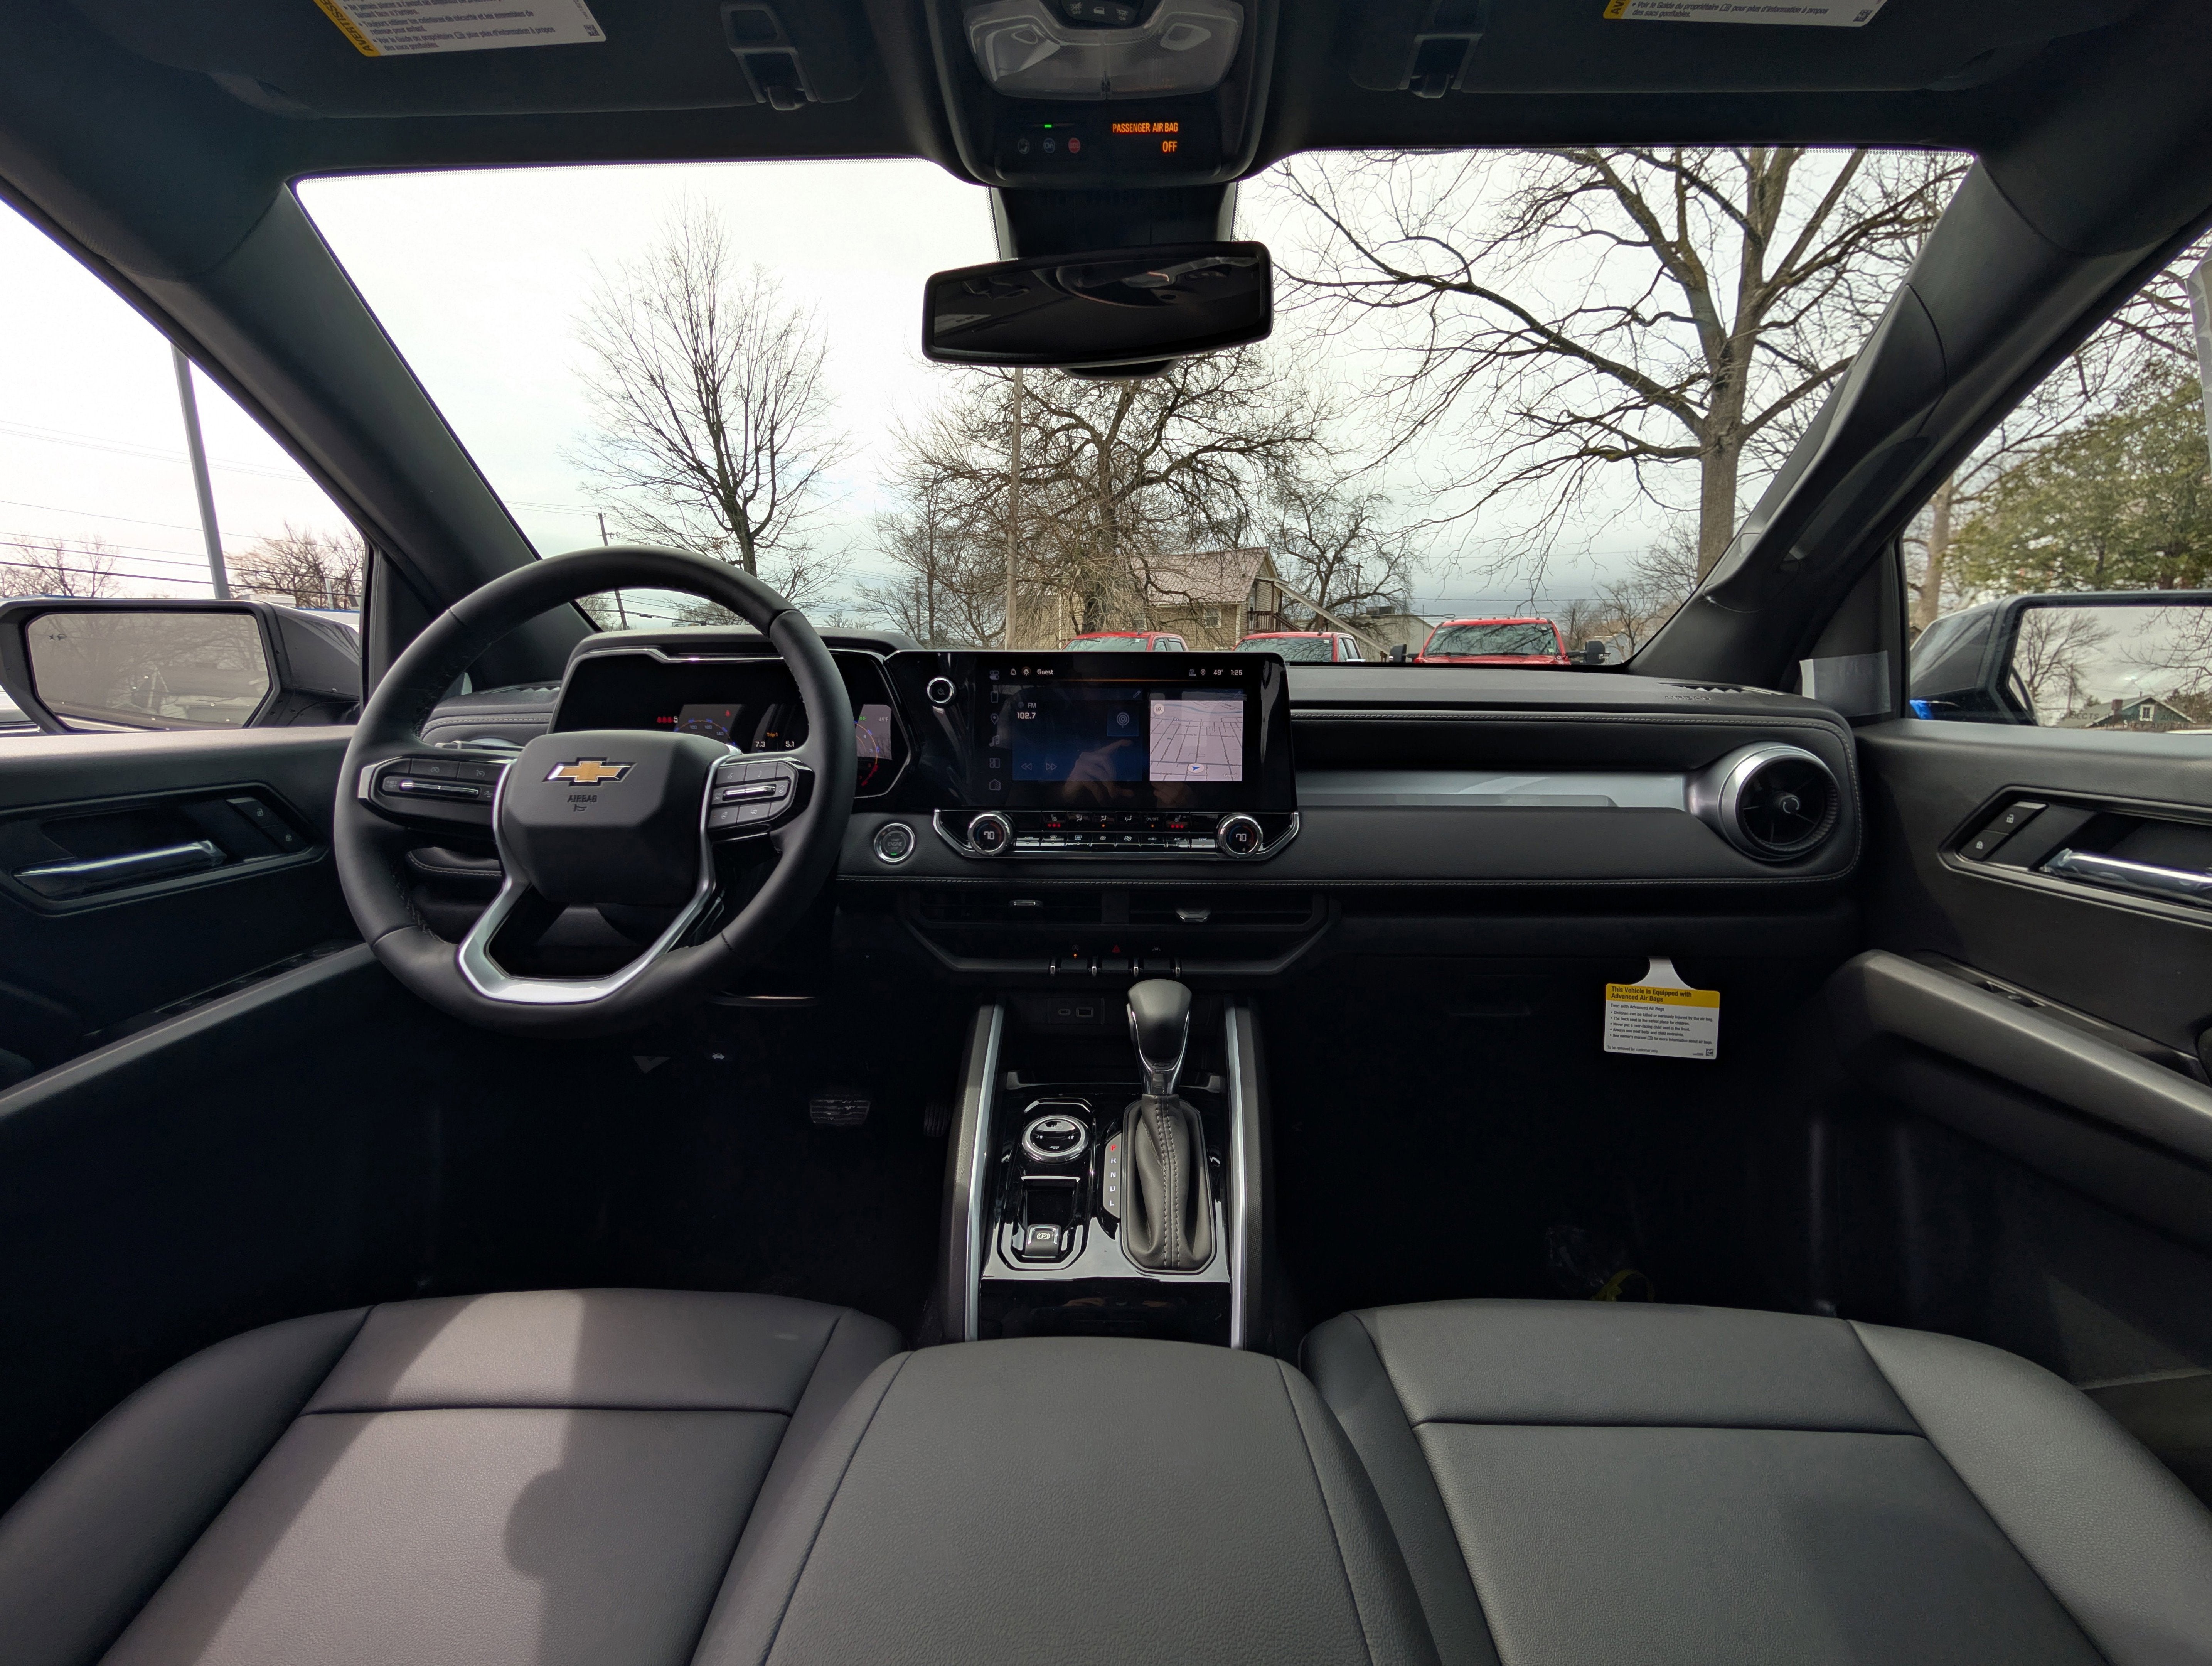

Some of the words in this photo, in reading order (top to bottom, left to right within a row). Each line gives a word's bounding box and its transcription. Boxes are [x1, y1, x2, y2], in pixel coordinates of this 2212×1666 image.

[1112, 123, 1150, 133] PASSENGER
[1152, 123, 1164, 132] AIR
[1164, 122, 1178, 132] BAG
[1162, 140, 1178, 152] OFF
[984, 831, 994, 840] 70
[1236, 833, 1247, 841] 70
